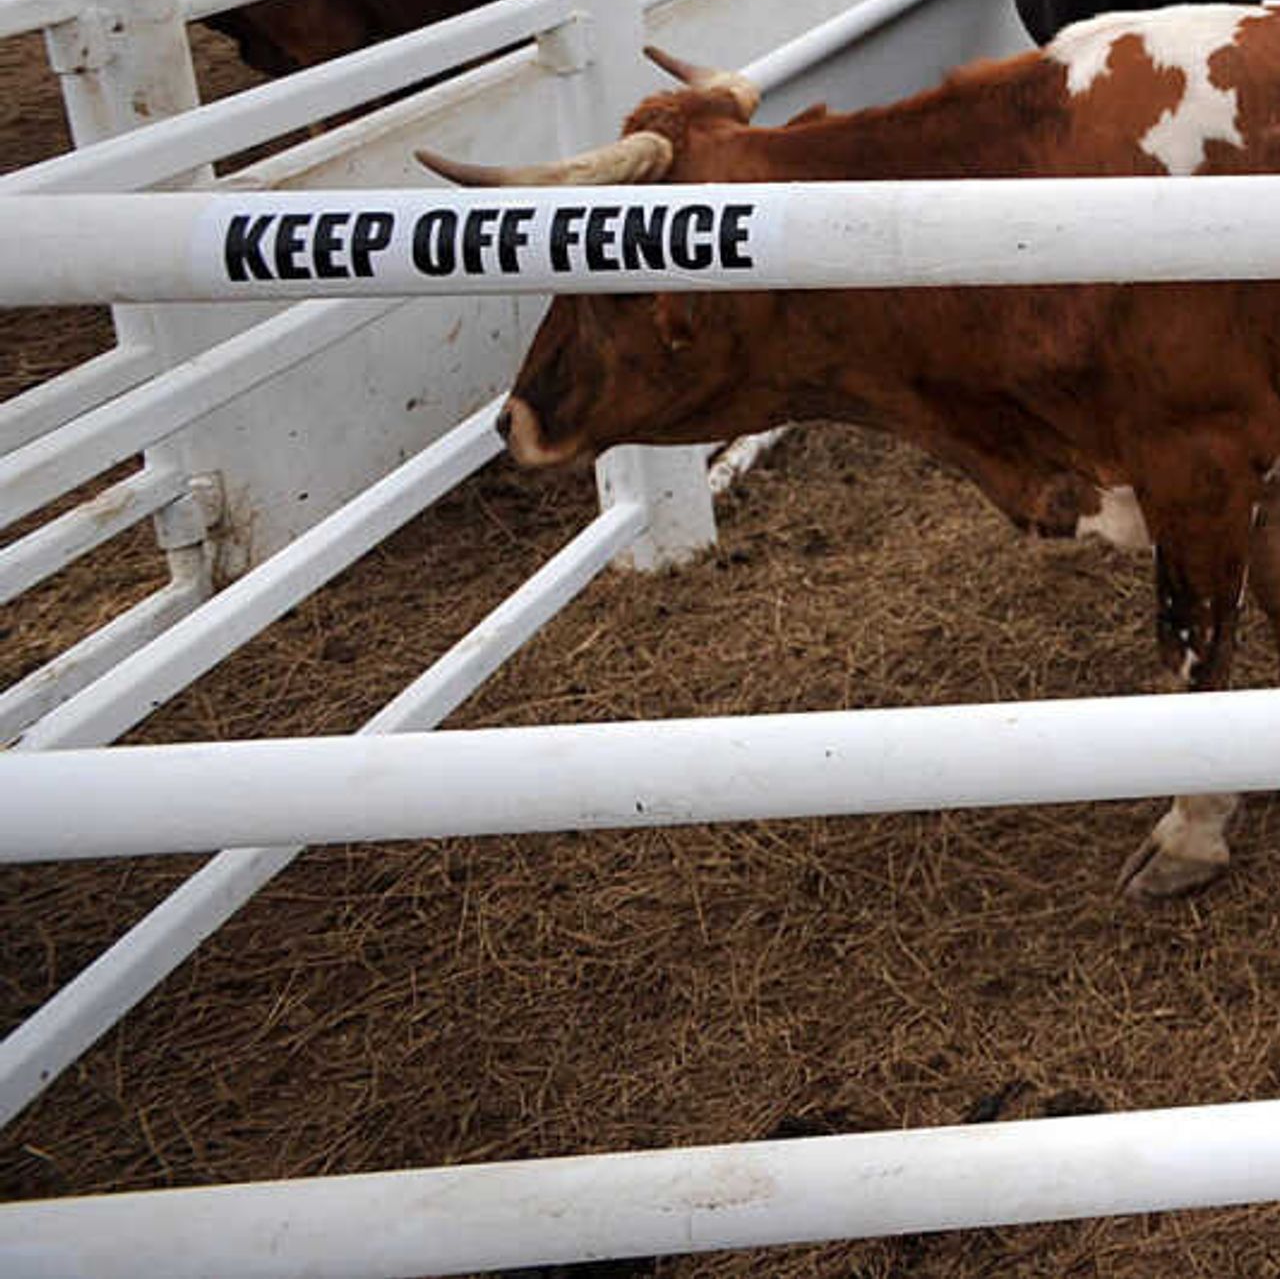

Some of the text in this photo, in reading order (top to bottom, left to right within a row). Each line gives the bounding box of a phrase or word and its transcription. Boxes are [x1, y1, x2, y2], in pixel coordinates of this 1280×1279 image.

[224, 205, 753, 282] KEEP OFF FENCE
